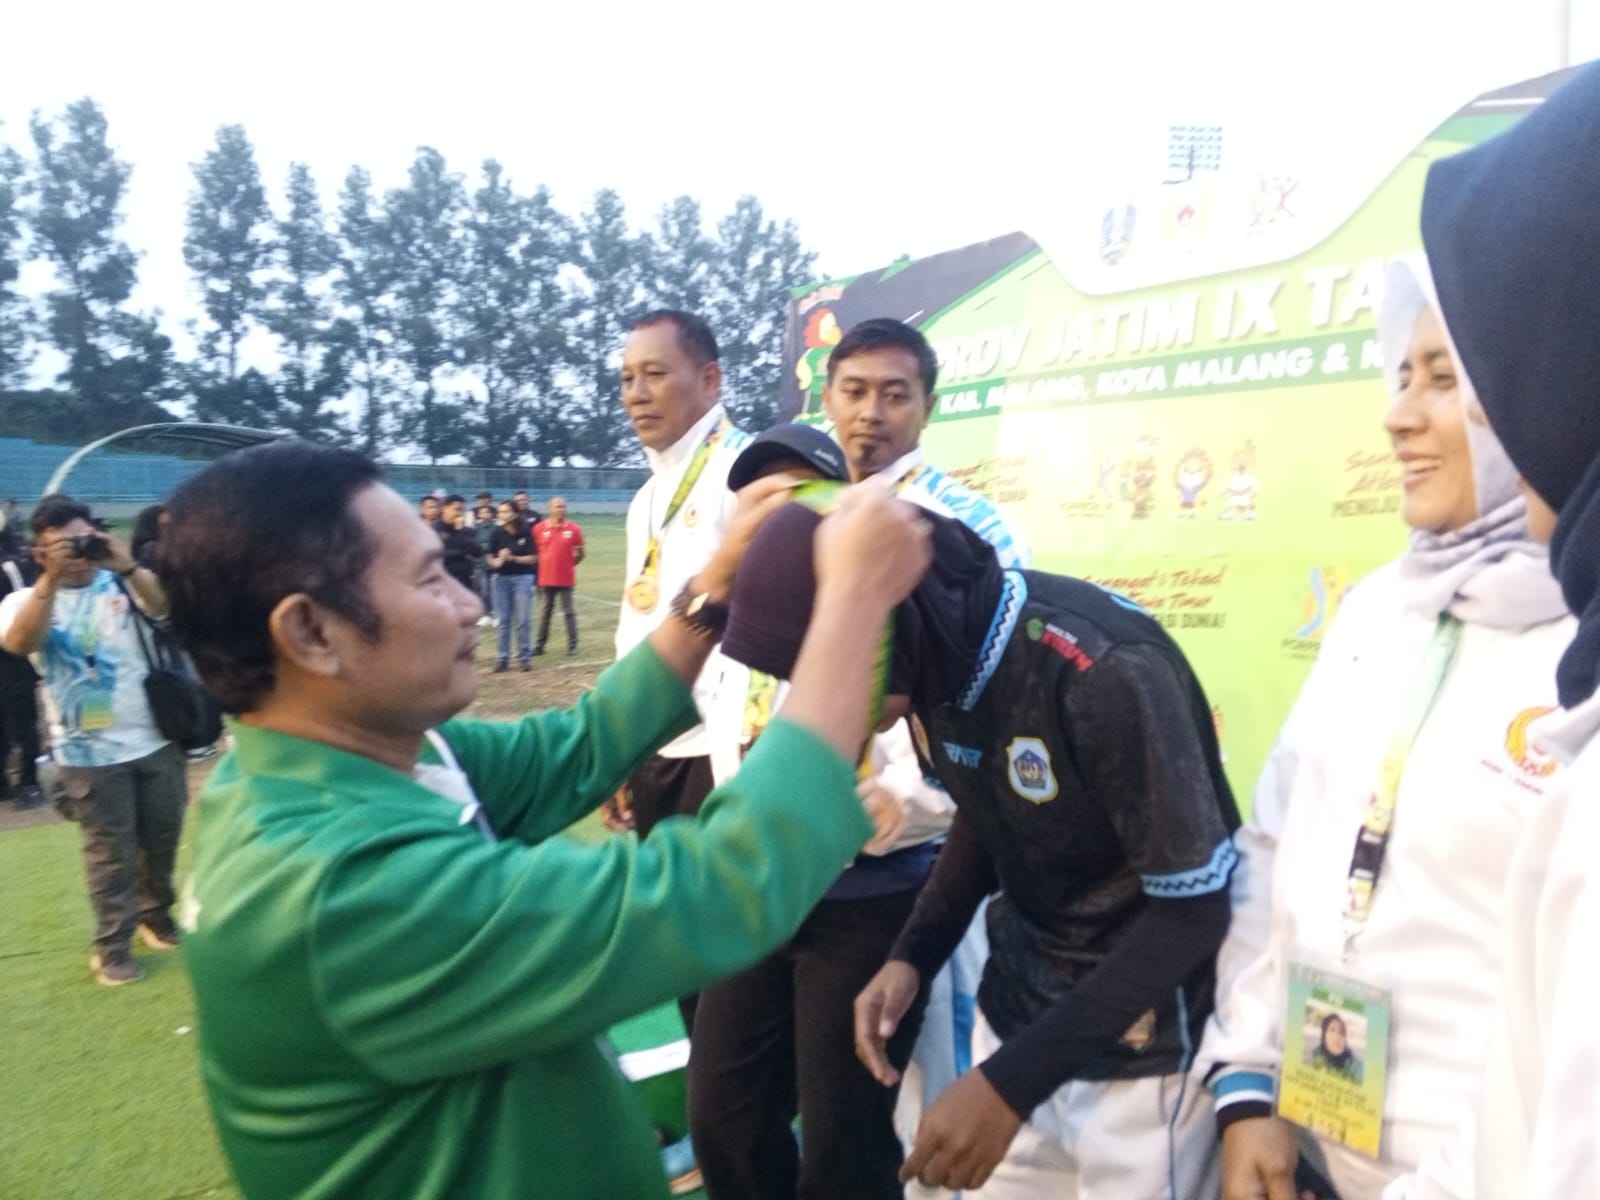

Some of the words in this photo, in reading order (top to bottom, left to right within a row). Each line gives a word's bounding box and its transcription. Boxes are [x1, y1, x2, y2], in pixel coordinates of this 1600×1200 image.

[1042, 290, 1200, 367] JATIM
[1214, 276, 1285, 344] IX
[1095, 364, 1167, 397] KOTA
[1172, 347, 1314, 389] MALANG
[1321, 342, 1349, 374] &
